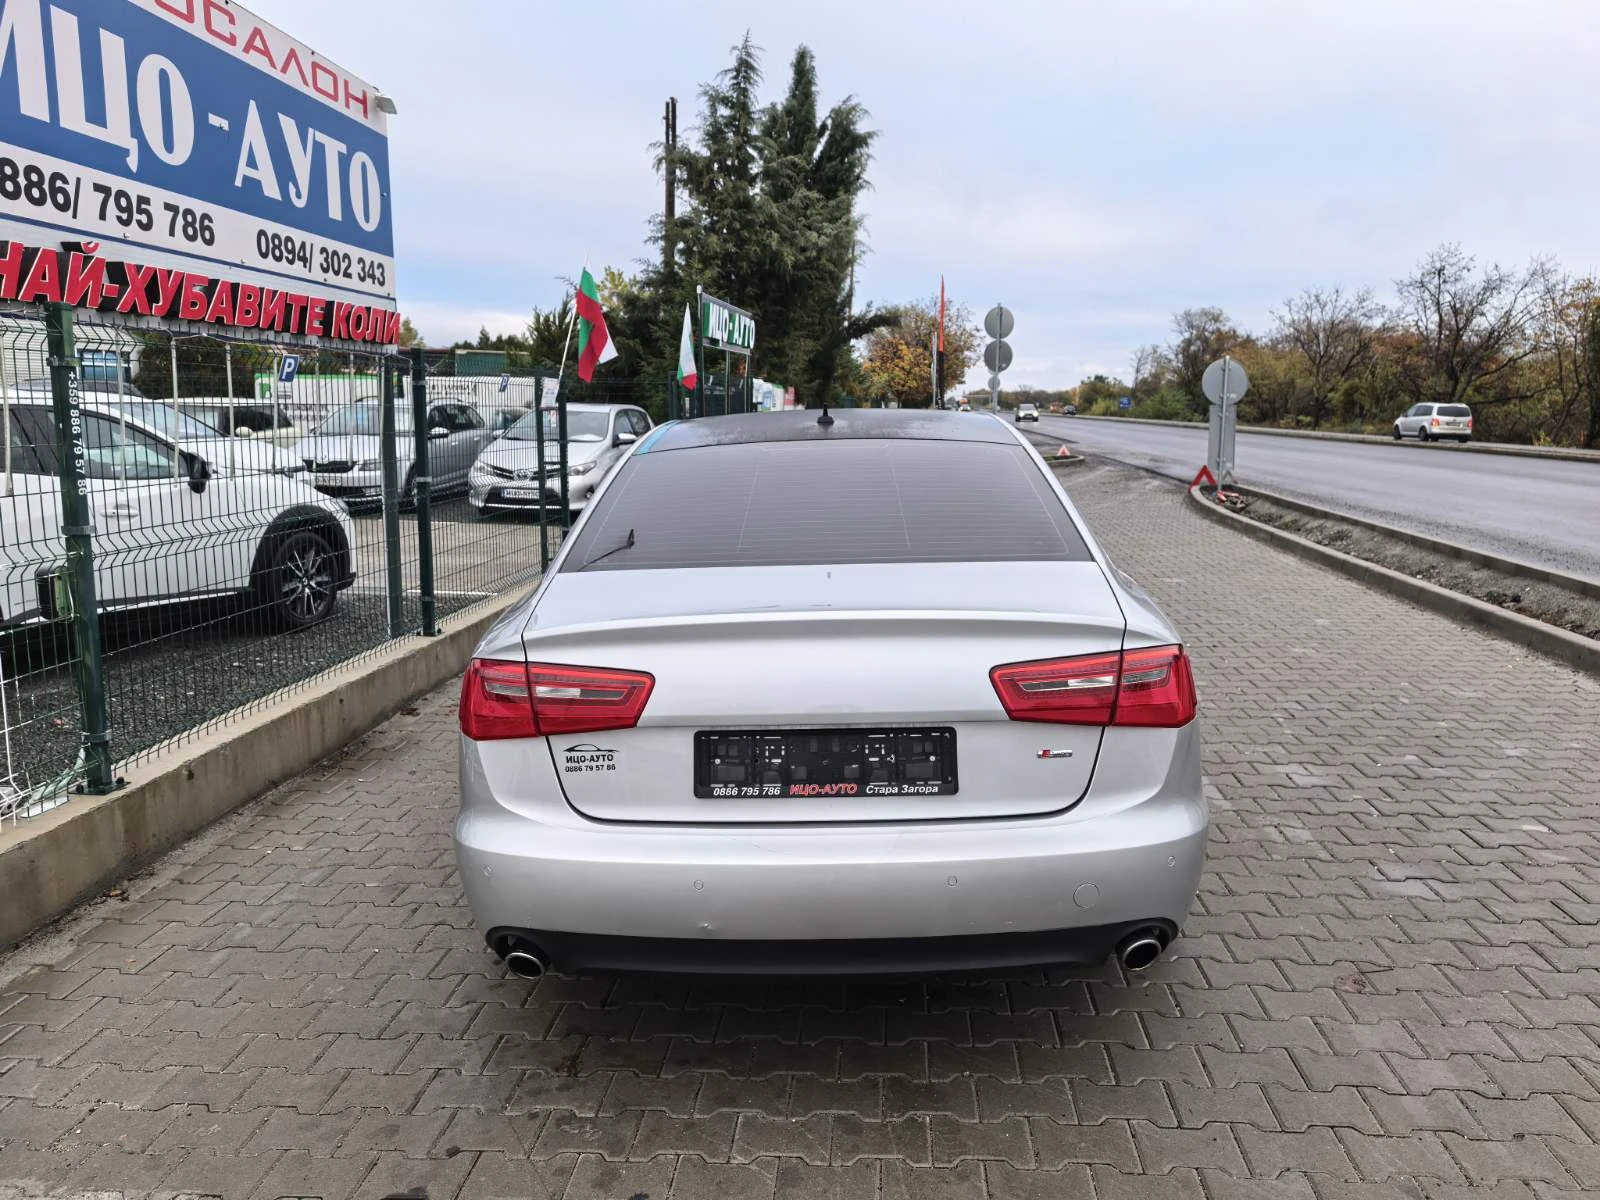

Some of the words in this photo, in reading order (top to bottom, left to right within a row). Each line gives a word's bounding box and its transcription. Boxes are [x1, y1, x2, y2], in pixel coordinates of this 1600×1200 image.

[93, 182, 154, 232] 795
[163, 202, 215, 247] 786
[319, 246, 353, 279] 302
[357, 257, 386, 287] 343
[0, 241, 326, 336] НАЙ-ХУБАВИТЕ
[332, 300, 401, 345] КОЛИ
[708, 302, 756, 350] ИЦО-АУТО
[68, 371, 79, 405] +359
[70, 409, 81, 434] 886
[73, 438, 83, 455] 79
[75, 459, 85, 475] 57
[77, 479, 88, 496] 86
[565, 753, 614, 765] ИЦО-АУТО
[565, 765, 583, 773] 0886
[713, 786, 739, 796] 0886
[741, 786, 760, 796] 795
[762, 786, 781, 796] 786
[789, 783, 858, 797] ИЦО-АУТО
[866, 785, 899, 797] Стара
[901, 784, 939, 797] Загора
